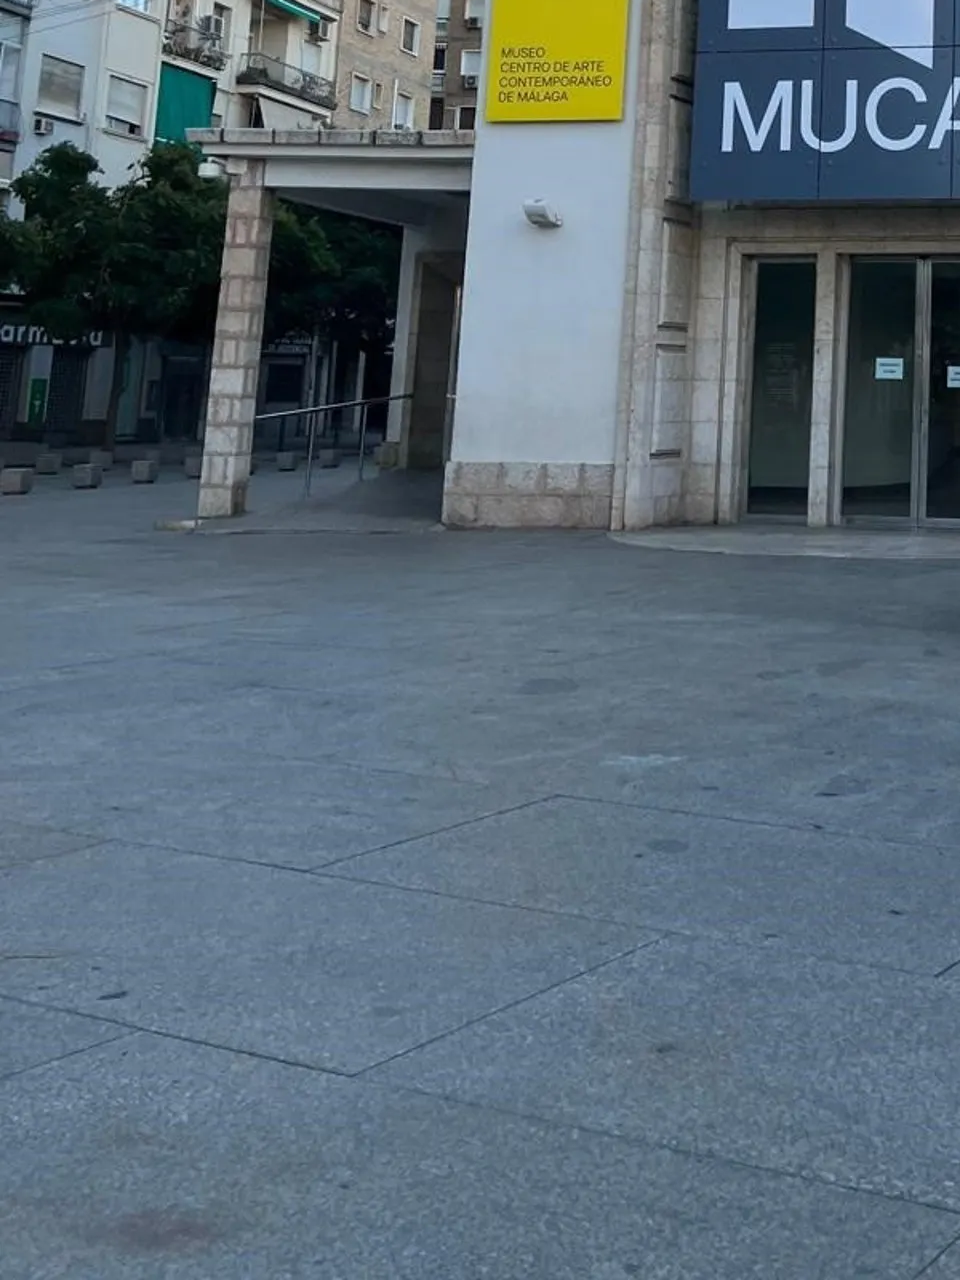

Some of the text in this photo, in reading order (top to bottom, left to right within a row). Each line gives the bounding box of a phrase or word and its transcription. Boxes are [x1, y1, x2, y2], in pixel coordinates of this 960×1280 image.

[501, 47, 546, 58] MUSEO
[500, 60, 605, 73] CENTRO DE ARTE
[498, 91, 514, 103] DE
